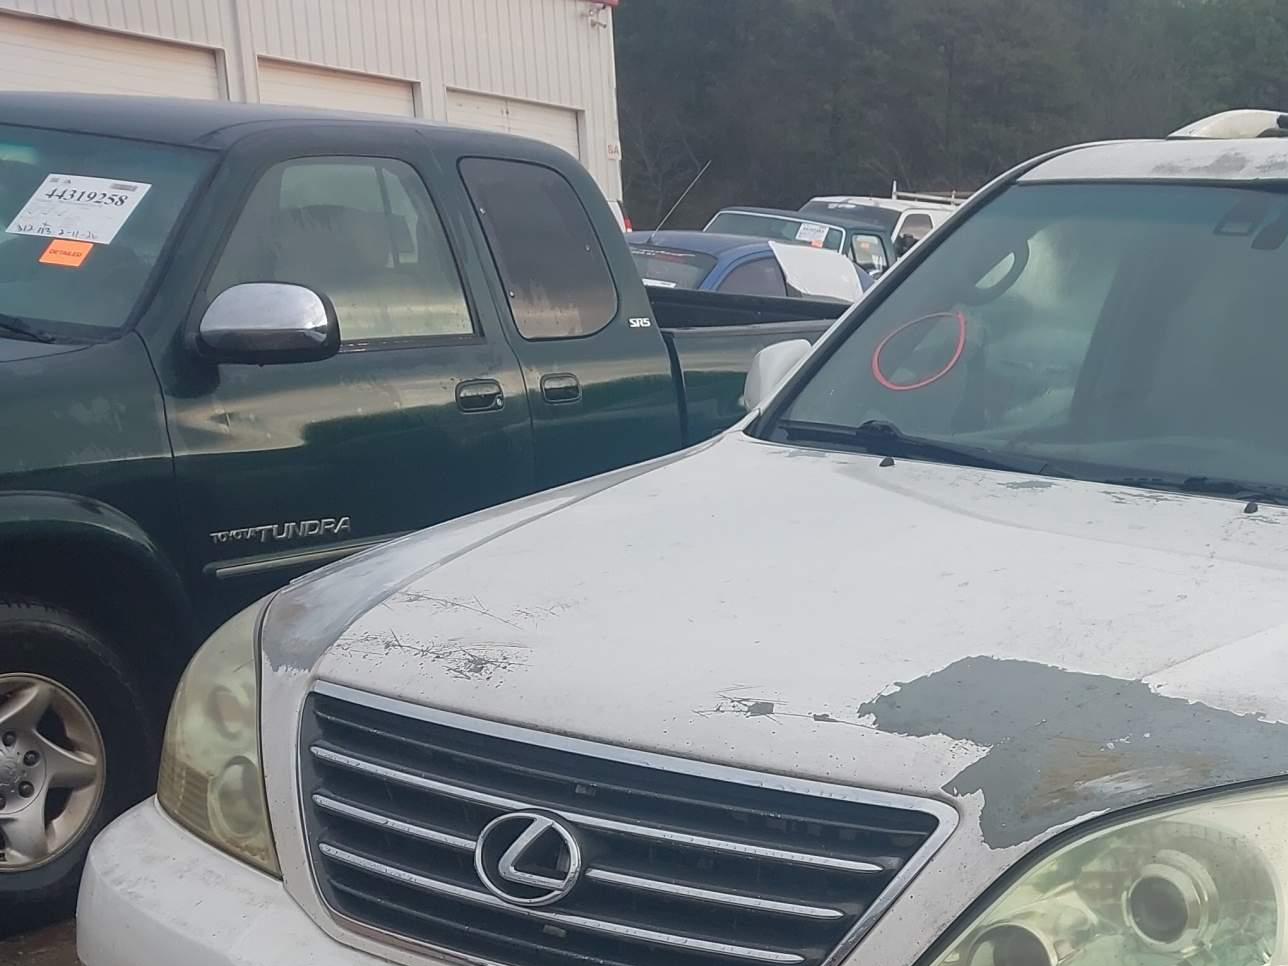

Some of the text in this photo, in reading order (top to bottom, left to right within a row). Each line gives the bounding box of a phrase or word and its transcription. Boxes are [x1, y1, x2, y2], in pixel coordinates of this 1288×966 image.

[45, 187, 129, 207] 44319258
[210, 516, 351, 544] TOYOTA TUNDRA
